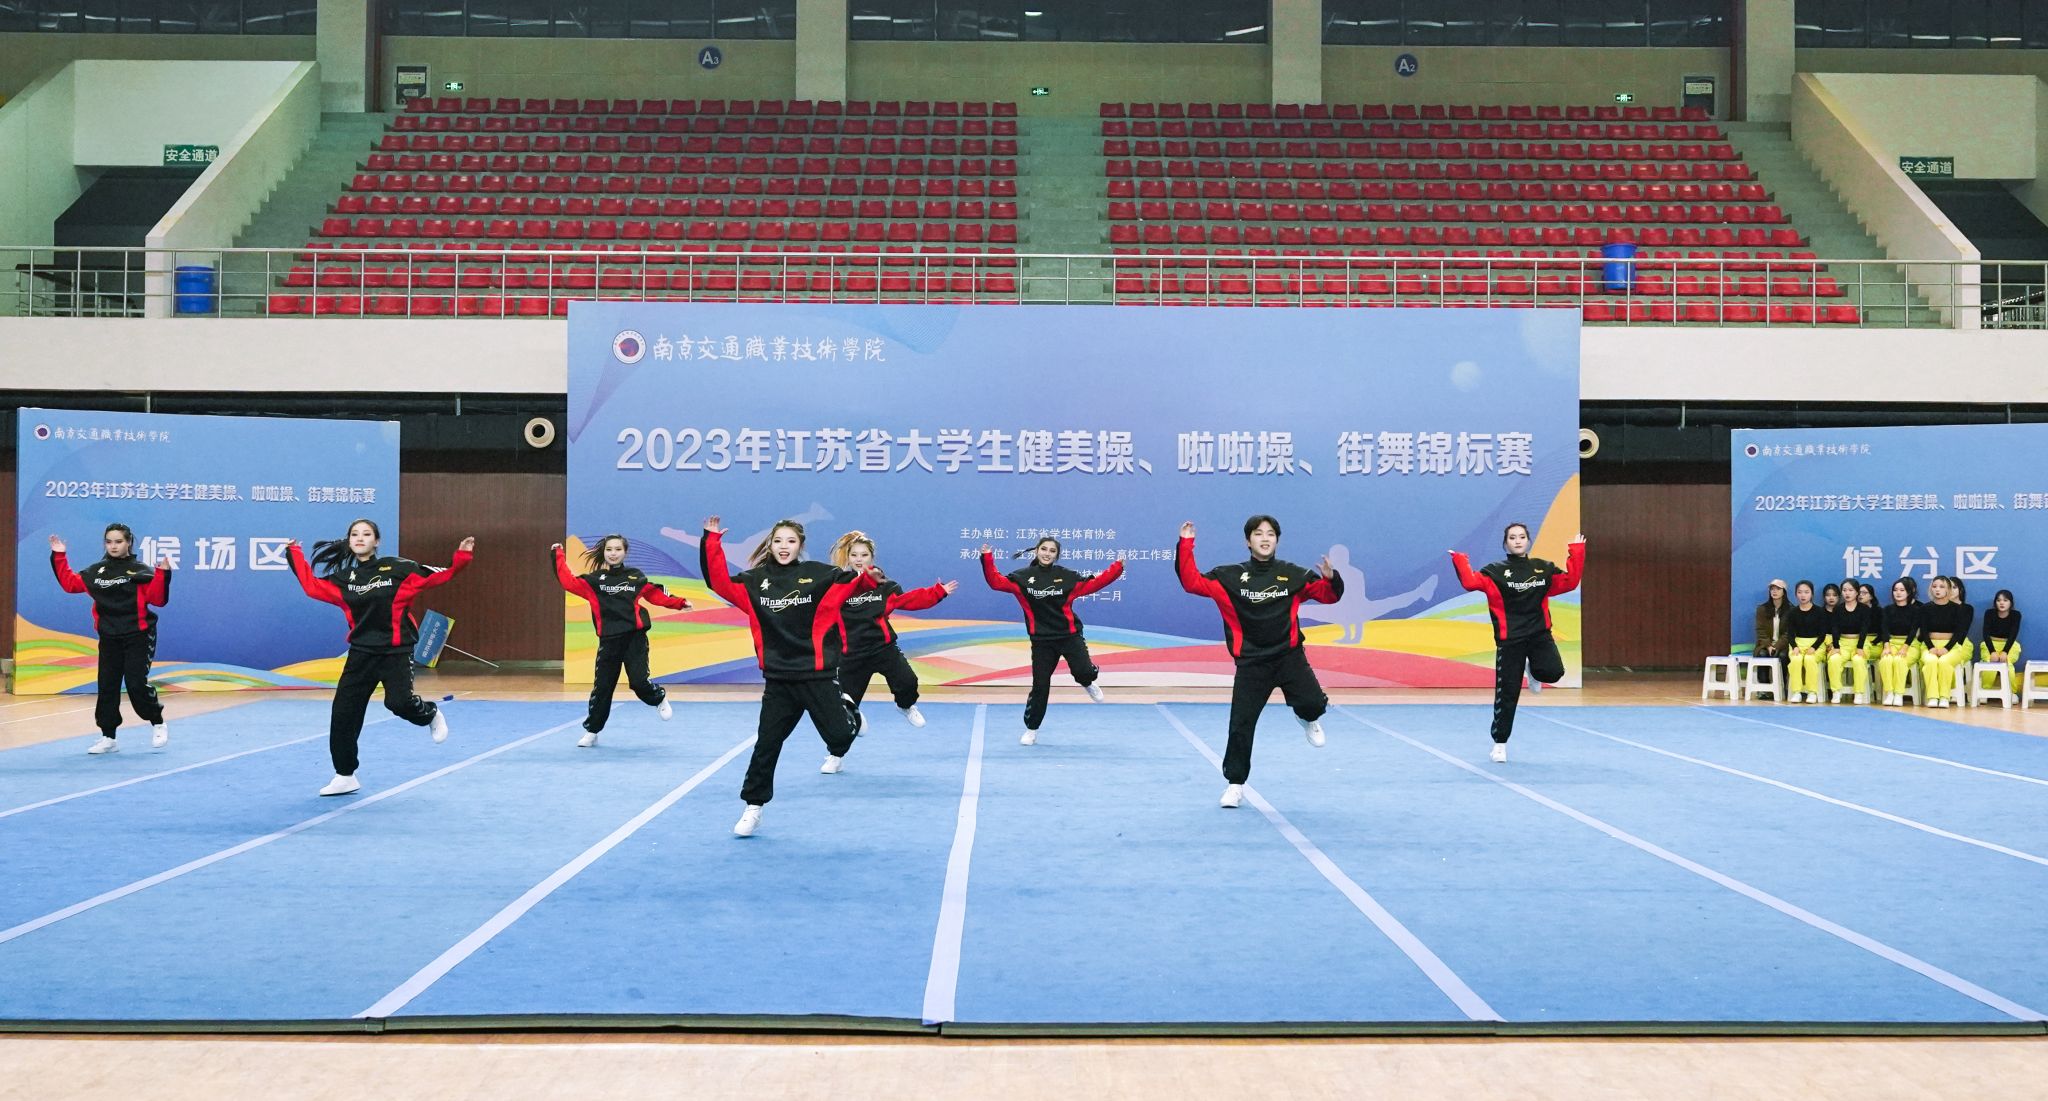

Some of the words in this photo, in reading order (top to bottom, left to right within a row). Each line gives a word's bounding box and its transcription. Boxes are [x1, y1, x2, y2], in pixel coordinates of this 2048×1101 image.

[165, 149, 218, 162] 安全通道
[1901, 160, 1953, 174] 安全通道
[1755, 493, 2048, 512] 2023年江苏省大学生健美操、啦啦操、街舞
[1507, 578, 1546, 589] Winnersquad
[1240, 588, 1289, 599] Winnersquad
[760, 594, 812, 607] Winnersquad
